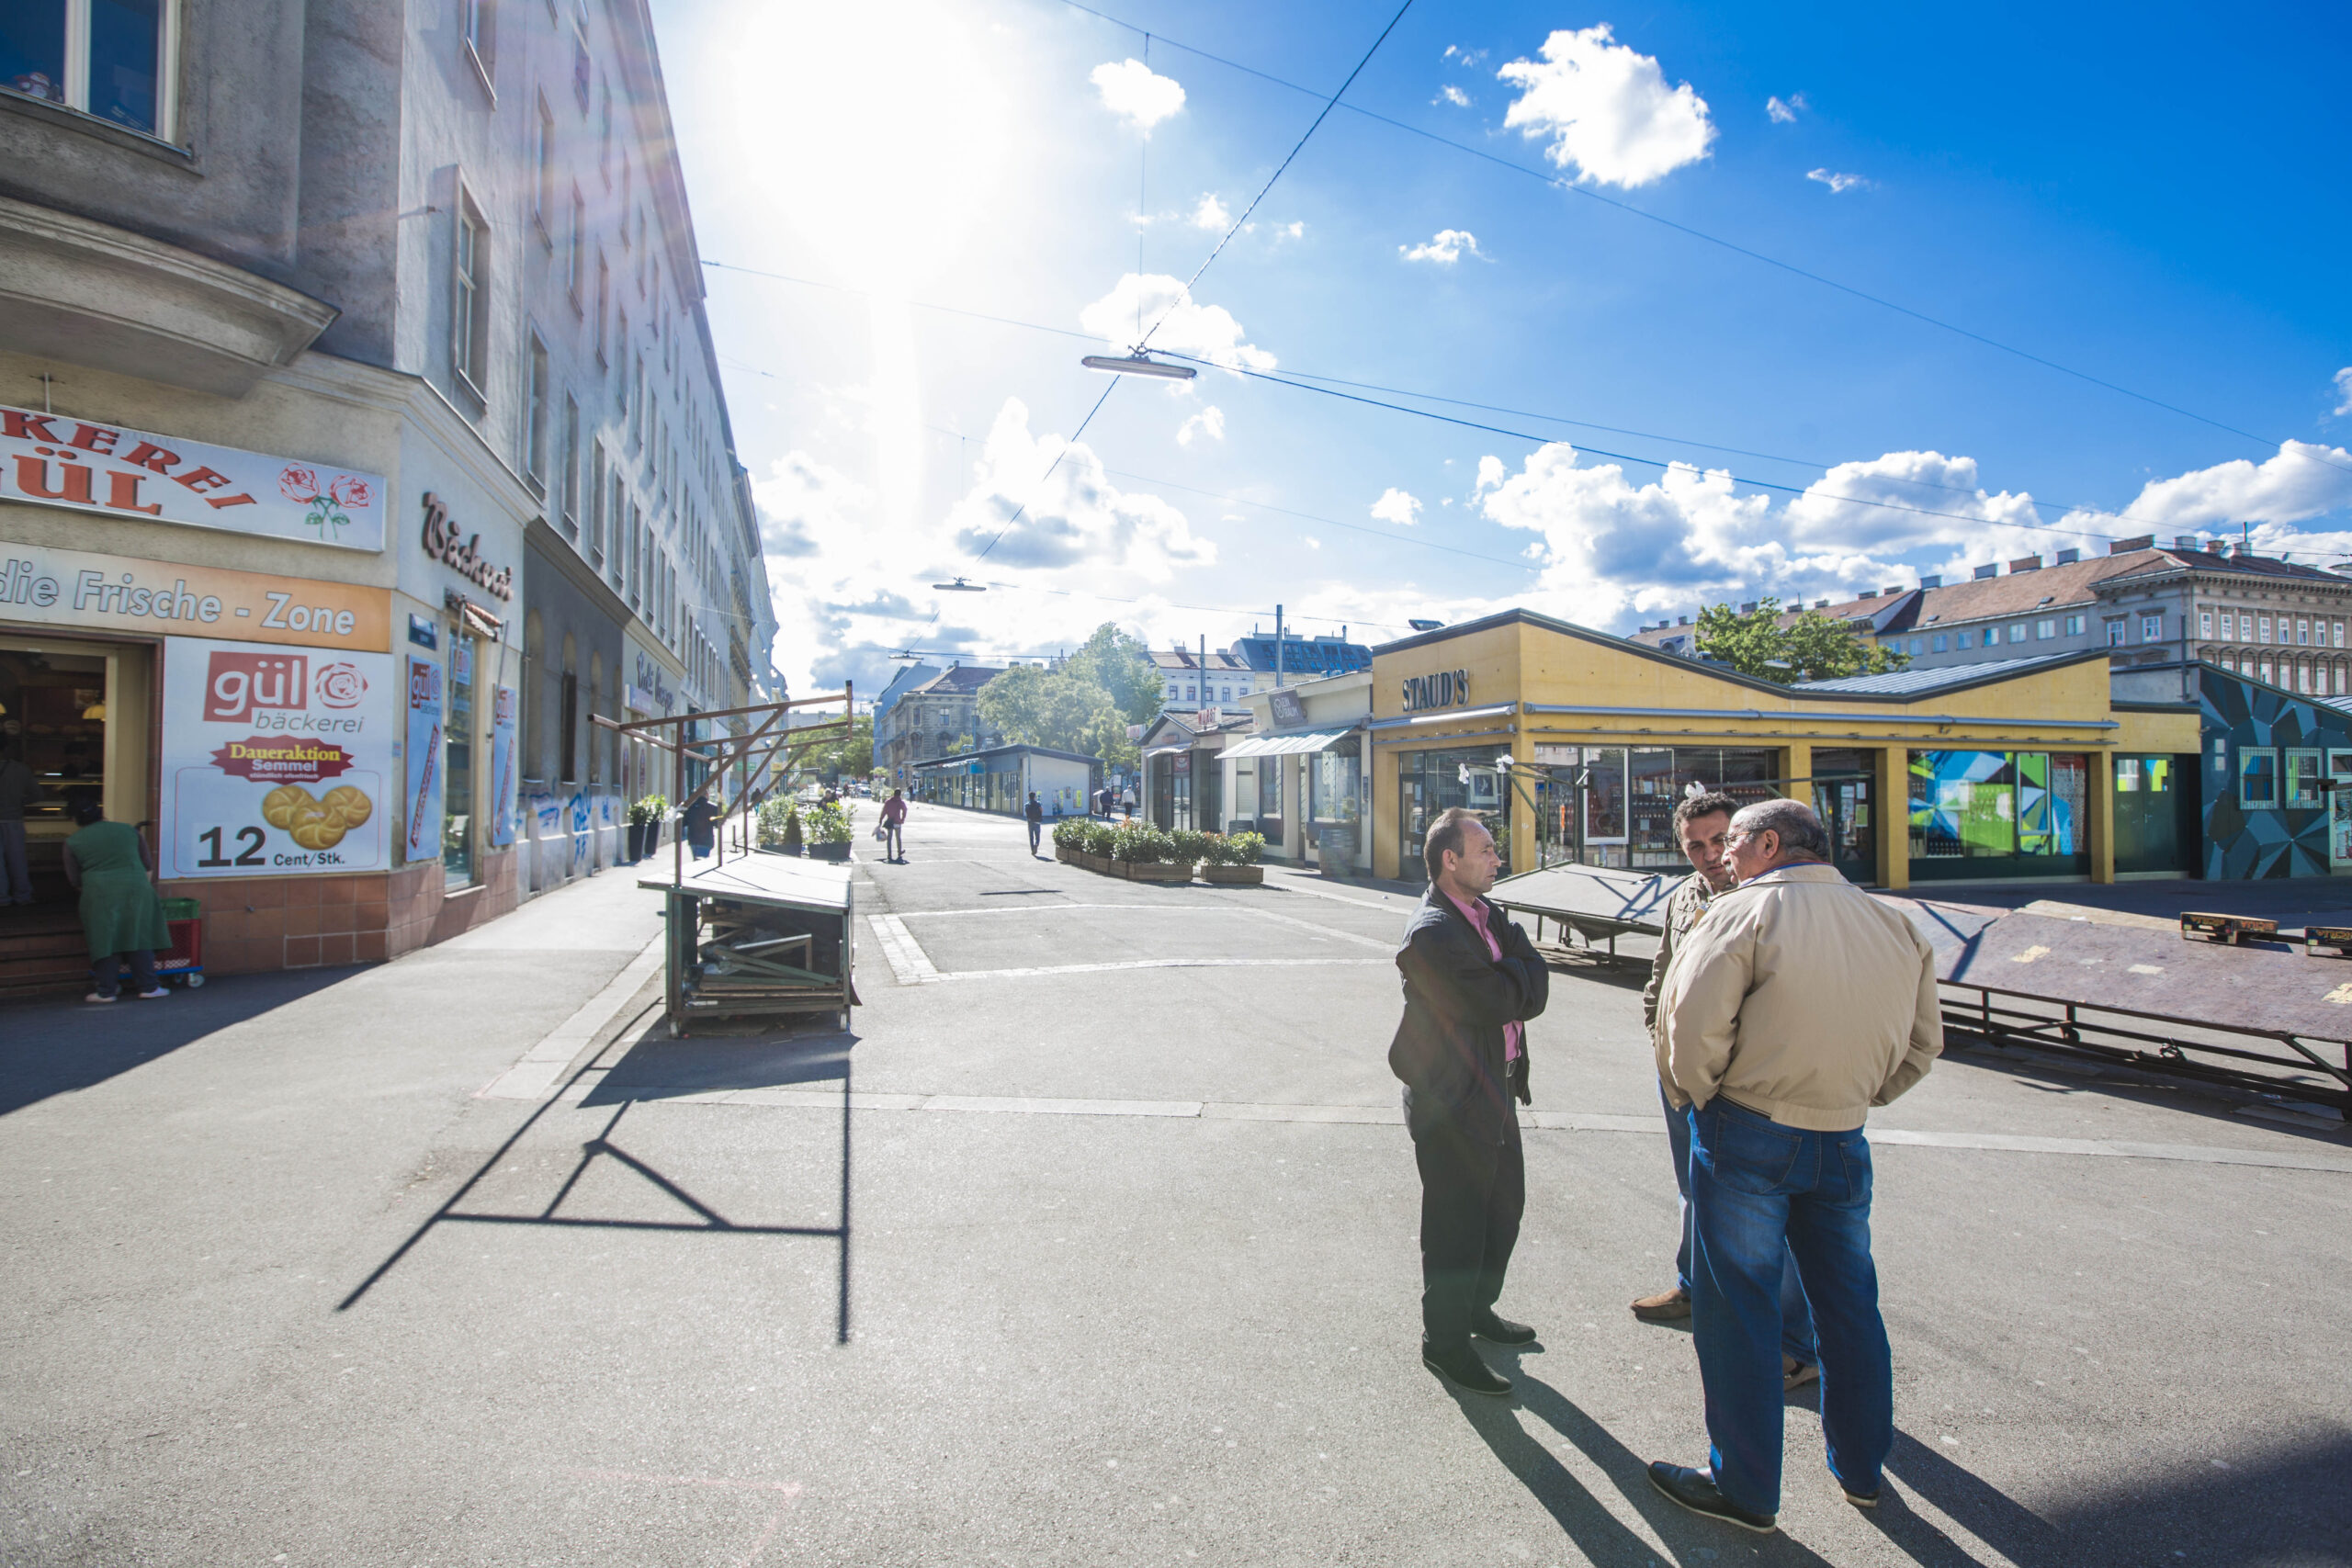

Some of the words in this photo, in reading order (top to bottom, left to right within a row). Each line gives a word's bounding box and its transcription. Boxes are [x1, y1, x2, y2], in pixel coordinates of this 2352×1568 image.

[0, 446, 163, 516] ÜL
[0, 558, 60, 607] die
[74, 570, 222, 624] Frische
[261, 591, 356, 636] Zone
[213, 659, 301, 716] gül
[1402, 668, 1469, 712] STAUD'S
[254, 710, 366, 734] bäckerei
[230, 743, 341, 761] Daueraktion
[252, 758, 318, 772] Semmel
[198, 826, 266, 868] 12
[274, 852, 345, 868] Cent/Stk.
